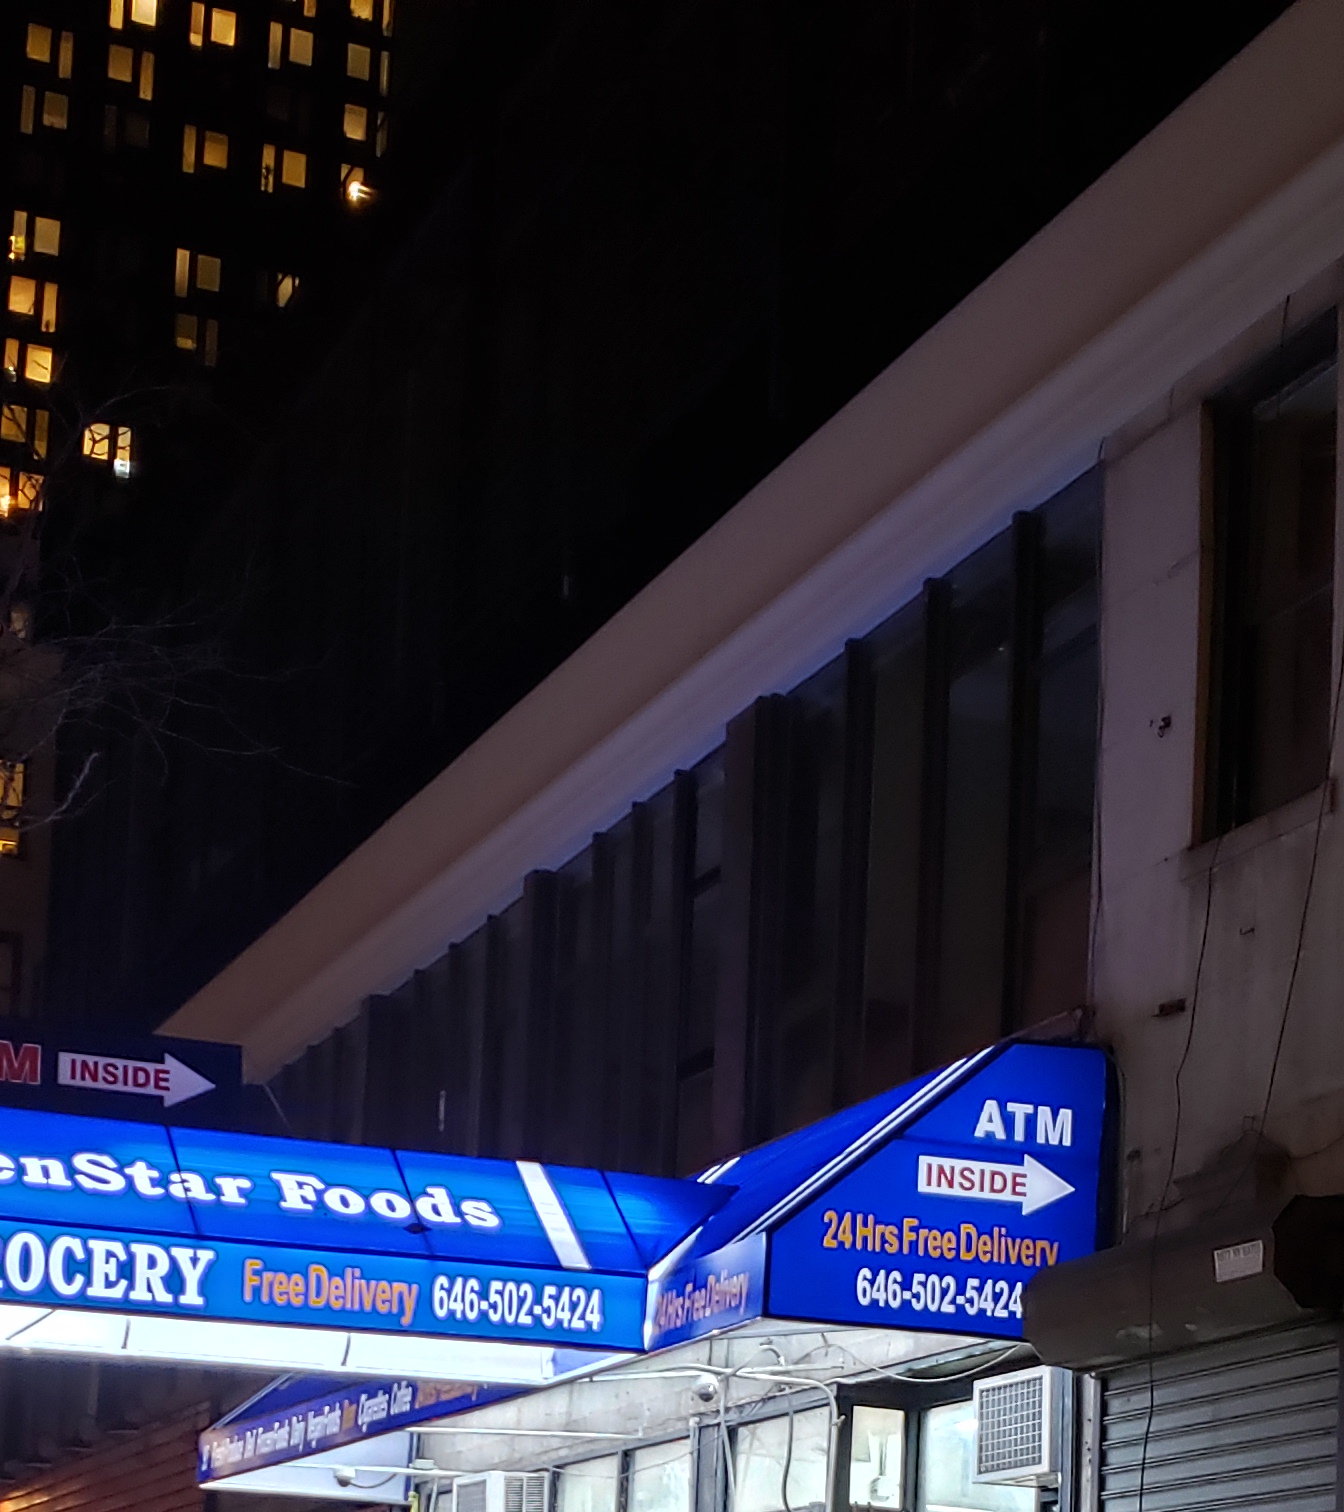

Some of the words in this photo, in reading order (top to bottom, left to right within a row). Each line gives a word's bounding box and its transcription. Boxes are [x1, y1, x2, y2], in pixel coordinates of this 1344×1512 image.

[70, 1058, 170, 1092] INSIDE
[974, 1099, 1073, 1147] ATM
[271, 1171, 502, 1229] Foods
[926, 1163, 1028, 1198] INSIDE
[903, 1218, 956, 1261] Free
[960, 1223, 1059, 1267] Delivery
[244, 1259, 306, 1306] Free
[308, 1263, 419, 1327] Delivery
[433, 1275, 603, 1333] 646-502-5424
[856, 1267, 1023, 1319] 646-502-5424
